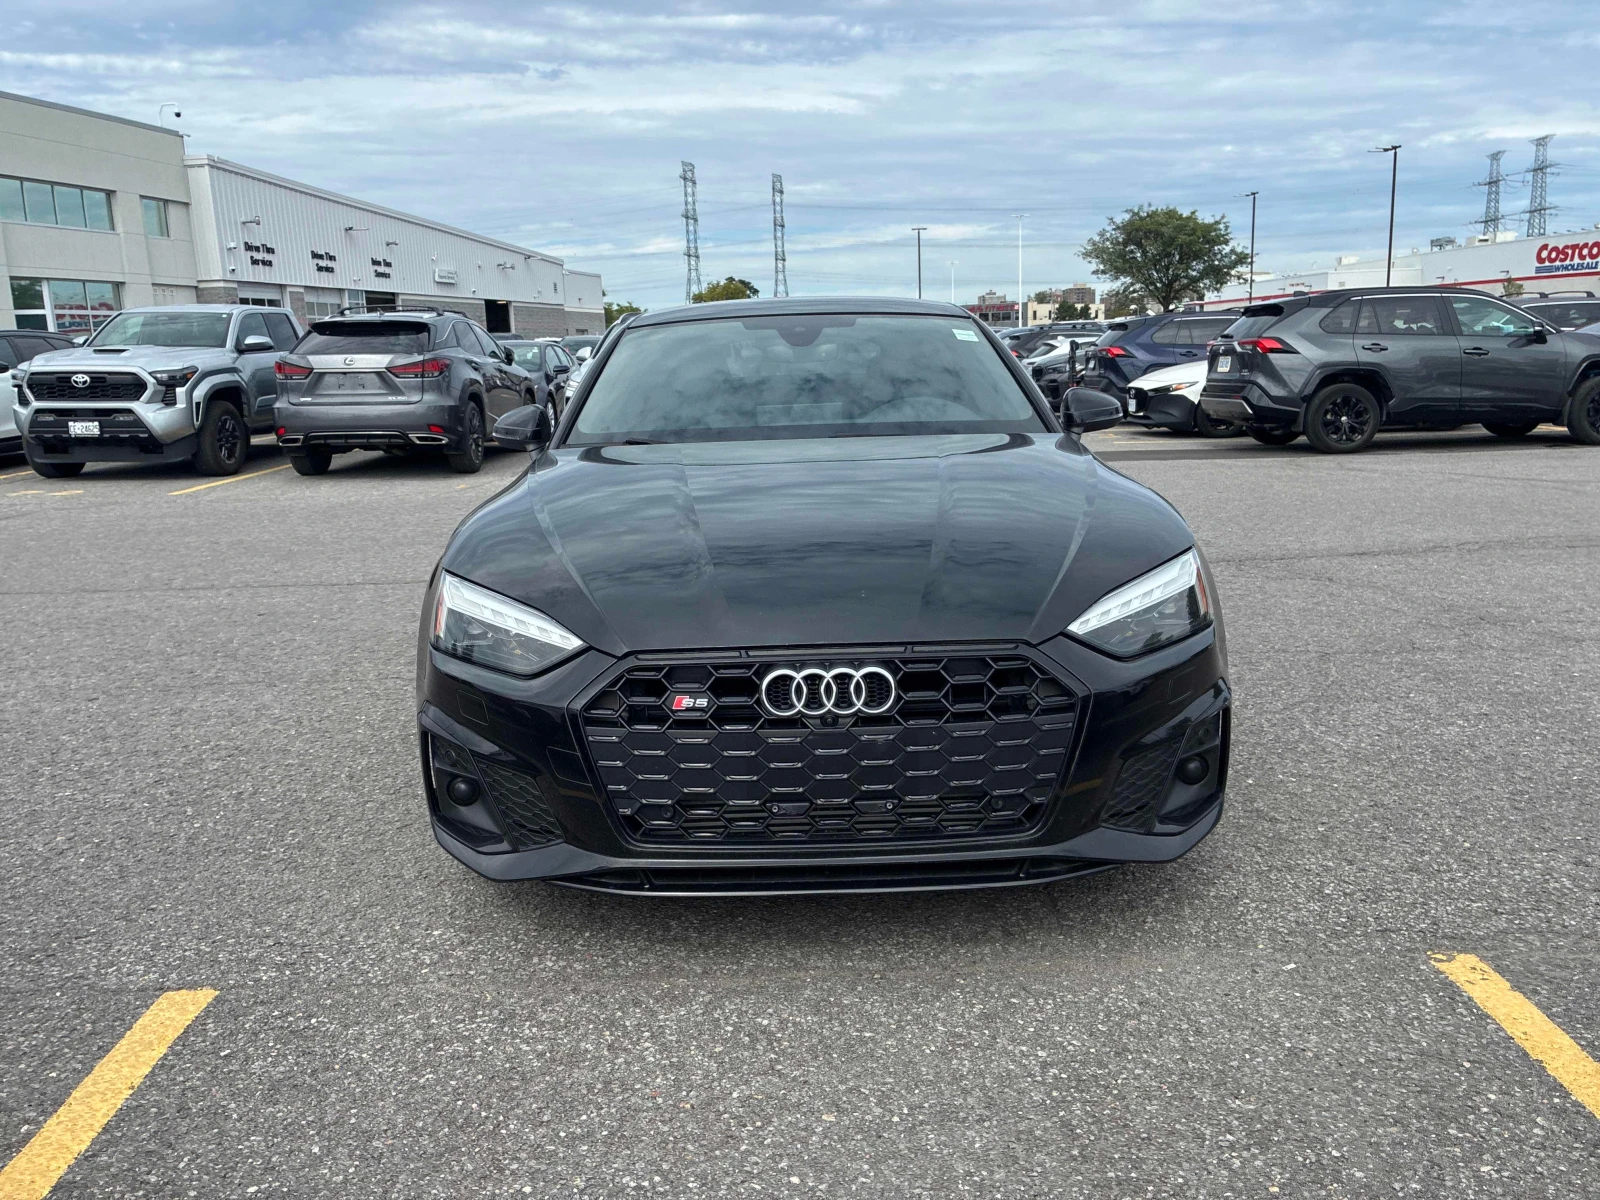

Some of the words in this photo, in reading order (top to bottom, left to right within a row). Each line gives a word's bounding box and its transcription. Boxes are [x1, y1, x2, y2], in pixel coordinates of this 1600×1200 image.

[244, 241, 261, 253] Drive
[261, 243, 275, 254] Thru
[1536, 241, 1600, 264] COSTCO
[250, 256, 273, 267] Service
[311, 250, 324, 261] Drive
[325, 251, 336, 262] Thru
[316, 263, 335, 273] Service
[1554, 261, 1599, 272] WHOLESALE
[374, 269, 391, 279] Service
[680, 698, 708, 707] S5
